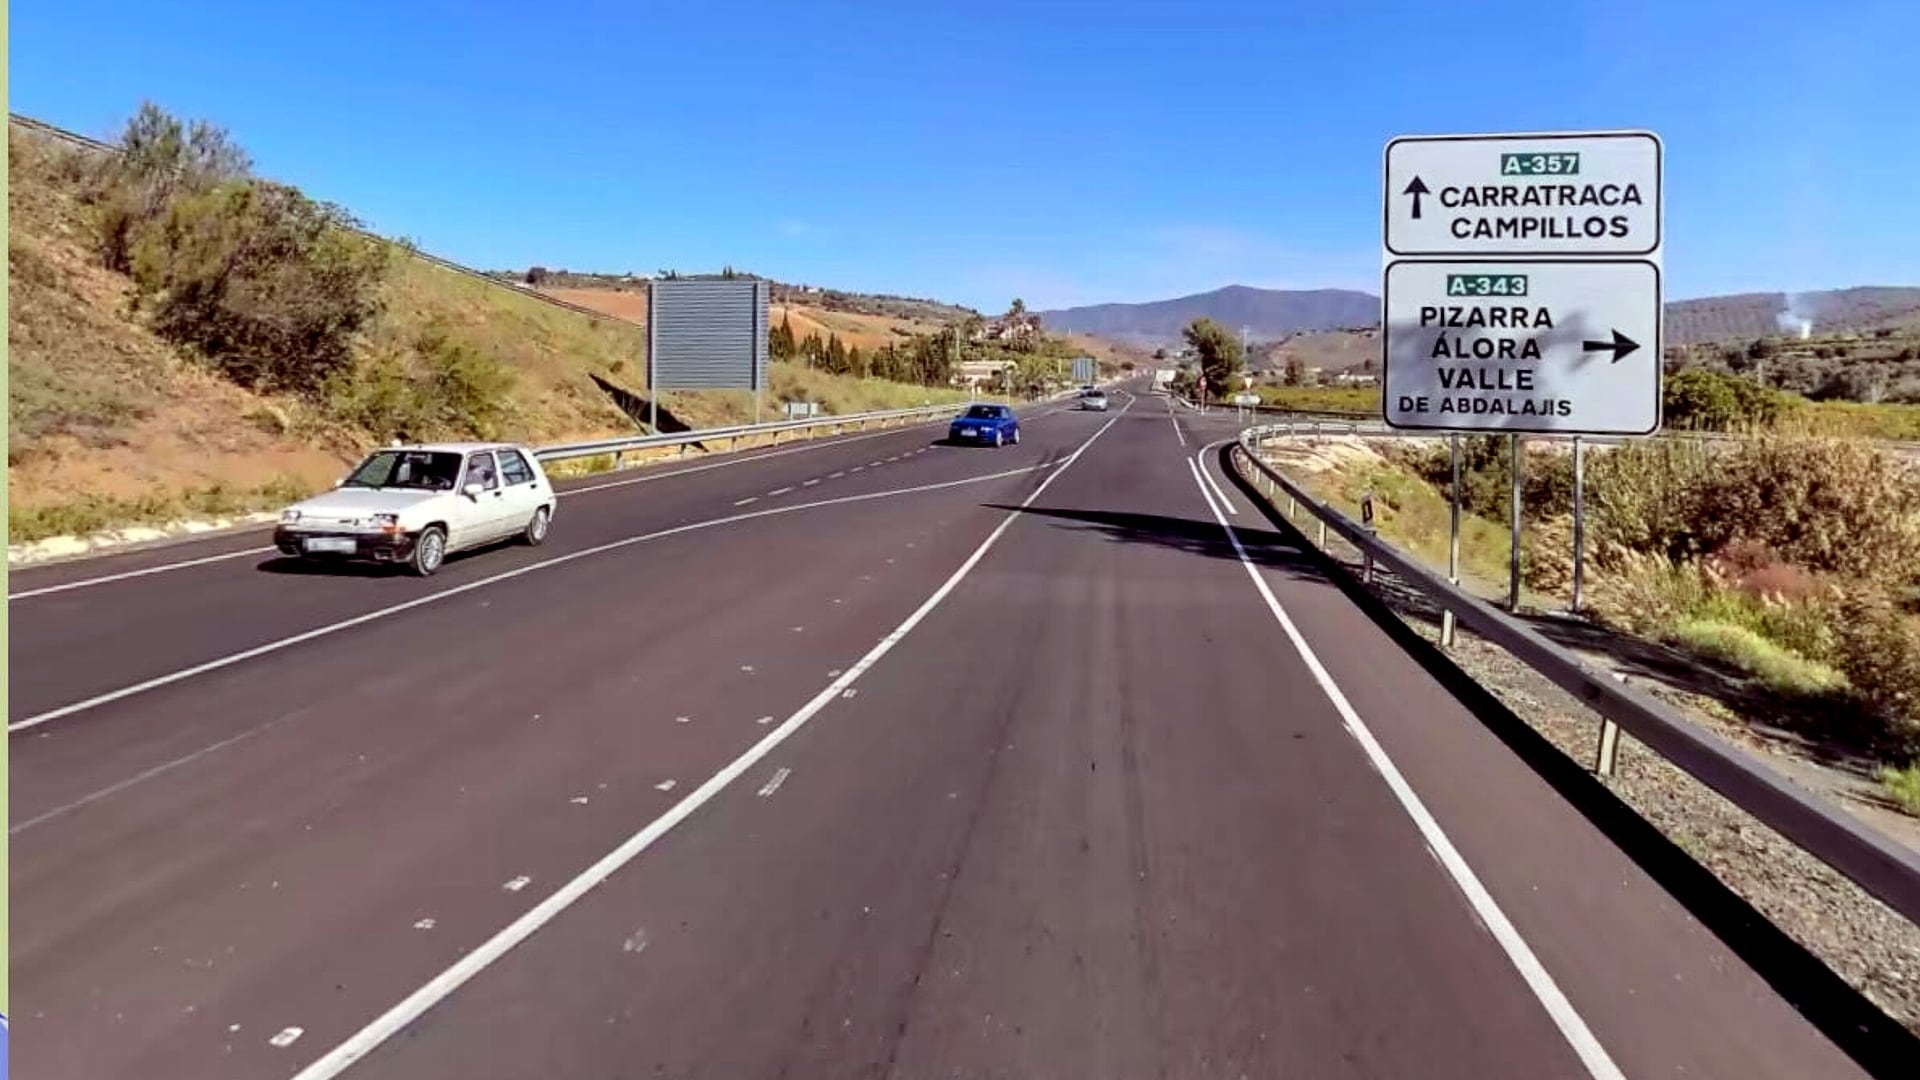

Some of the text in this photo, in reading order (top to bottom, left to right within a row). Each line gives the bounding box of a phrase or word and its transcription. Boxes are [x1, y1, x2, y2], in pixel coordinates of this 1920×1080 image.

[1502, 154, 1578, 173] A-357
[1439, 183, 1642, 207] CARRATRACA
[1450, 216, 1629, 239] CAMPILLOS
[1450, 276, 1526, 295] A-343
[1420, 306, 1554, 329] PIZARRA
[1431, 331, 1541, 359] ÁLORA
[1437, 367, 1534, 391] VALLE
[1398, 396, 1572, 416] DE ABDALAJIS
